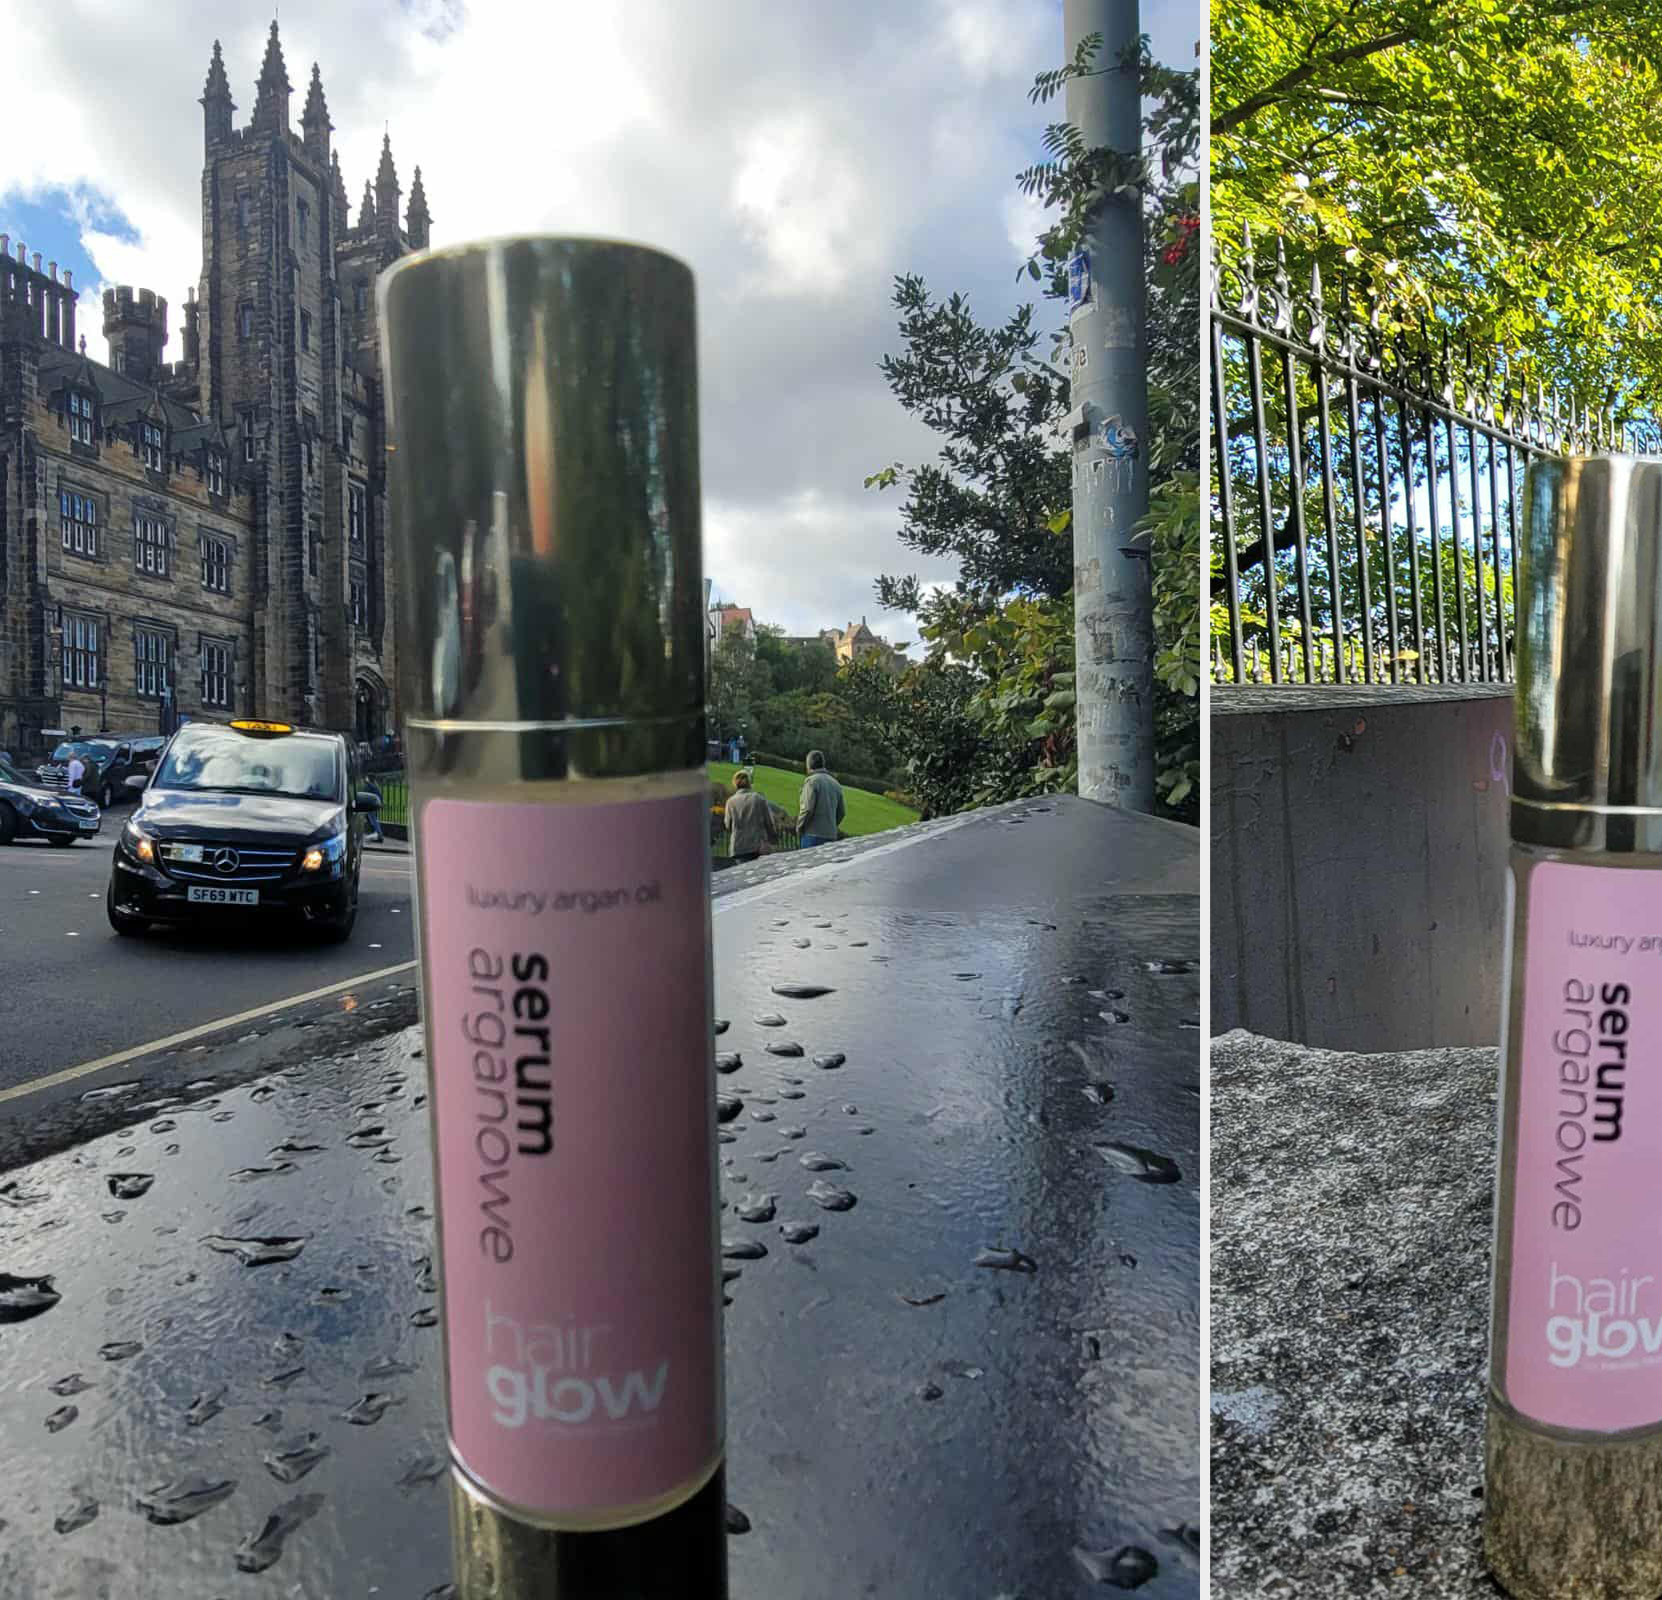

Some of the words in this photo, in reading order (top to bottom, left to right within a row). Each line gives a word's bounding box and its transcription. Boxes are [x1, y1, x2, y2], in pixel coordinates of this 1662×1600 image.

[193, 889, 226, 902] SF69
[465, 883, 544, 916] luxury
[552, 885, 629, 913] argan
[1568, 929, 1635, 954] luxury
[511, 951, 555, 1158] serum
[1593, 981, 1632, 1143] serum
[461, 947, 514, 1265] arganowe
[1551, 977, 1596, 1232] arganowe
[1548, 1261, 1655, 1316] hair
[485, 1298, 614, 1372] hair
[486, 1357, 670, 1428] glow
